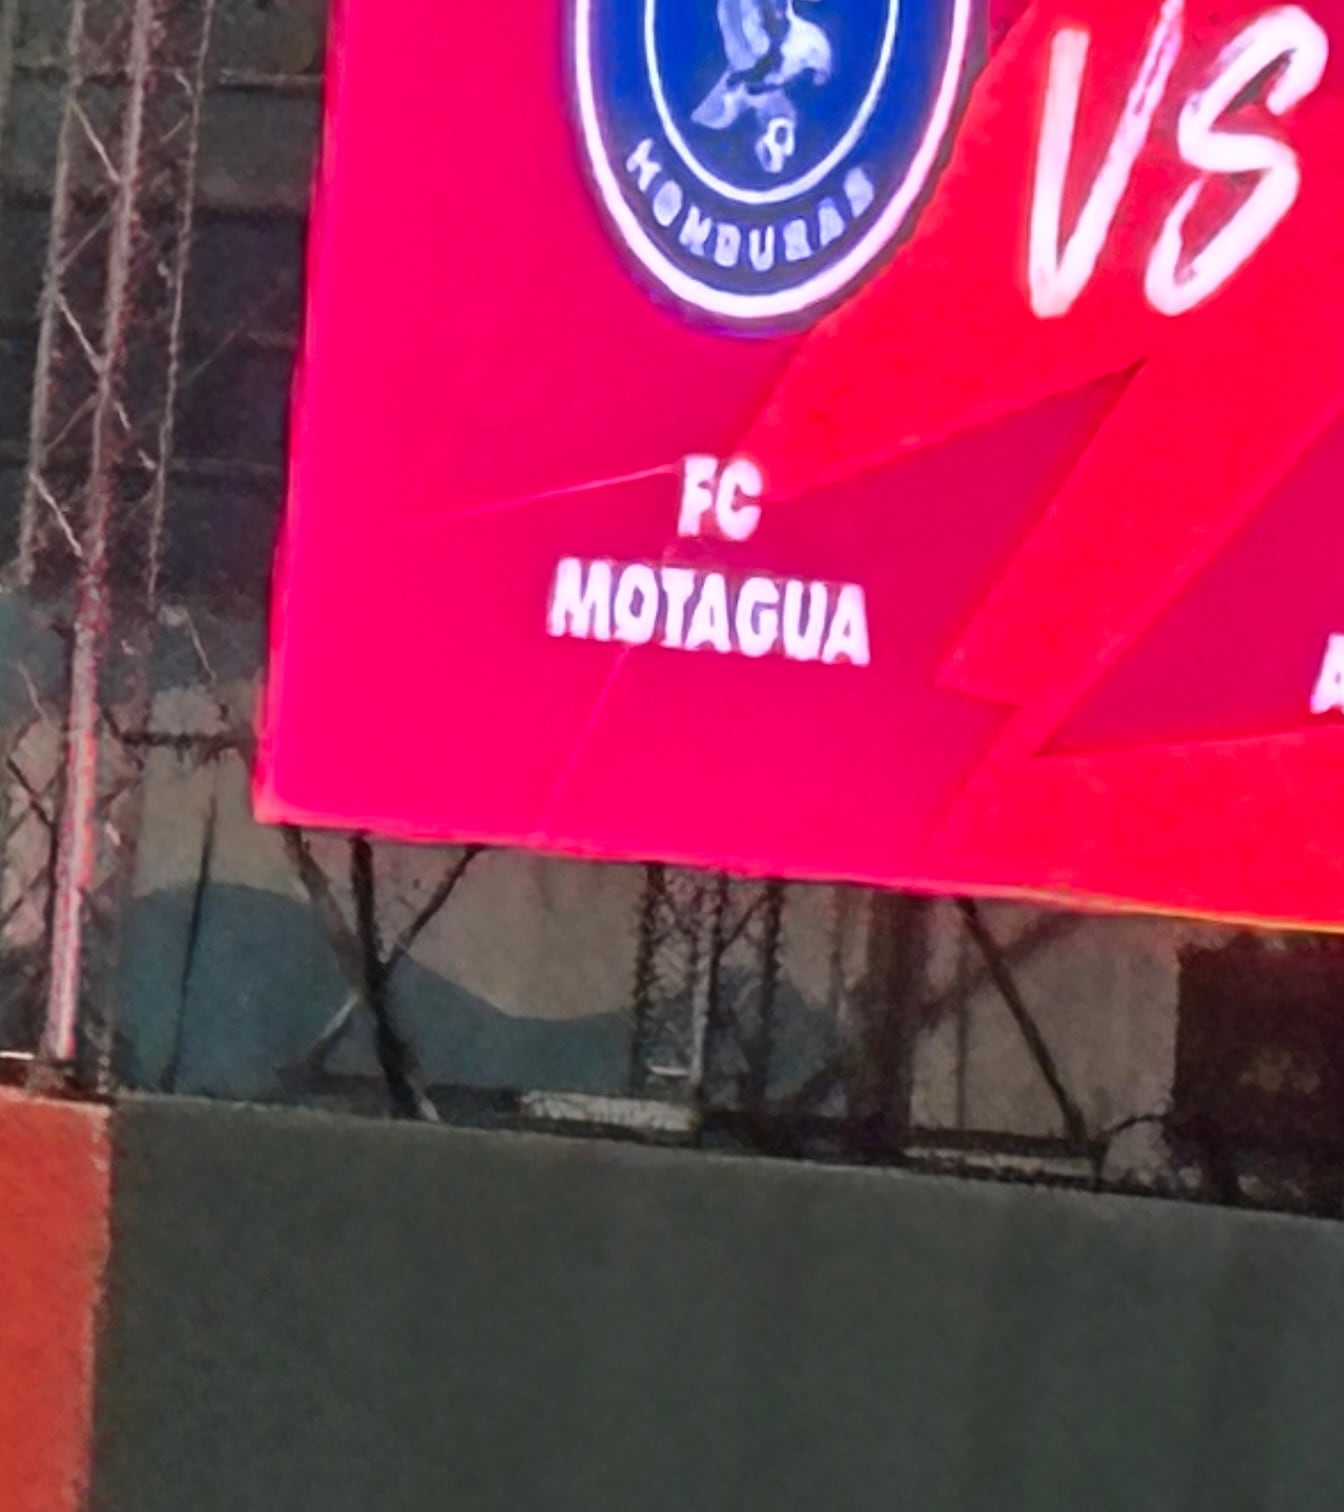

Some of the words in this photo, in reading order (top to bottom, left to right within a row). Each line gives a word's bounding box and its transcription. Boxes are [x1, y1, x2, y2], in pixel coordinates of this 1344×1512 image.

[625, 136, 877, 273] HONDURAS
[676, 453, 764, 543] FC
[546, 555, 872, 668] MOTAGUA
